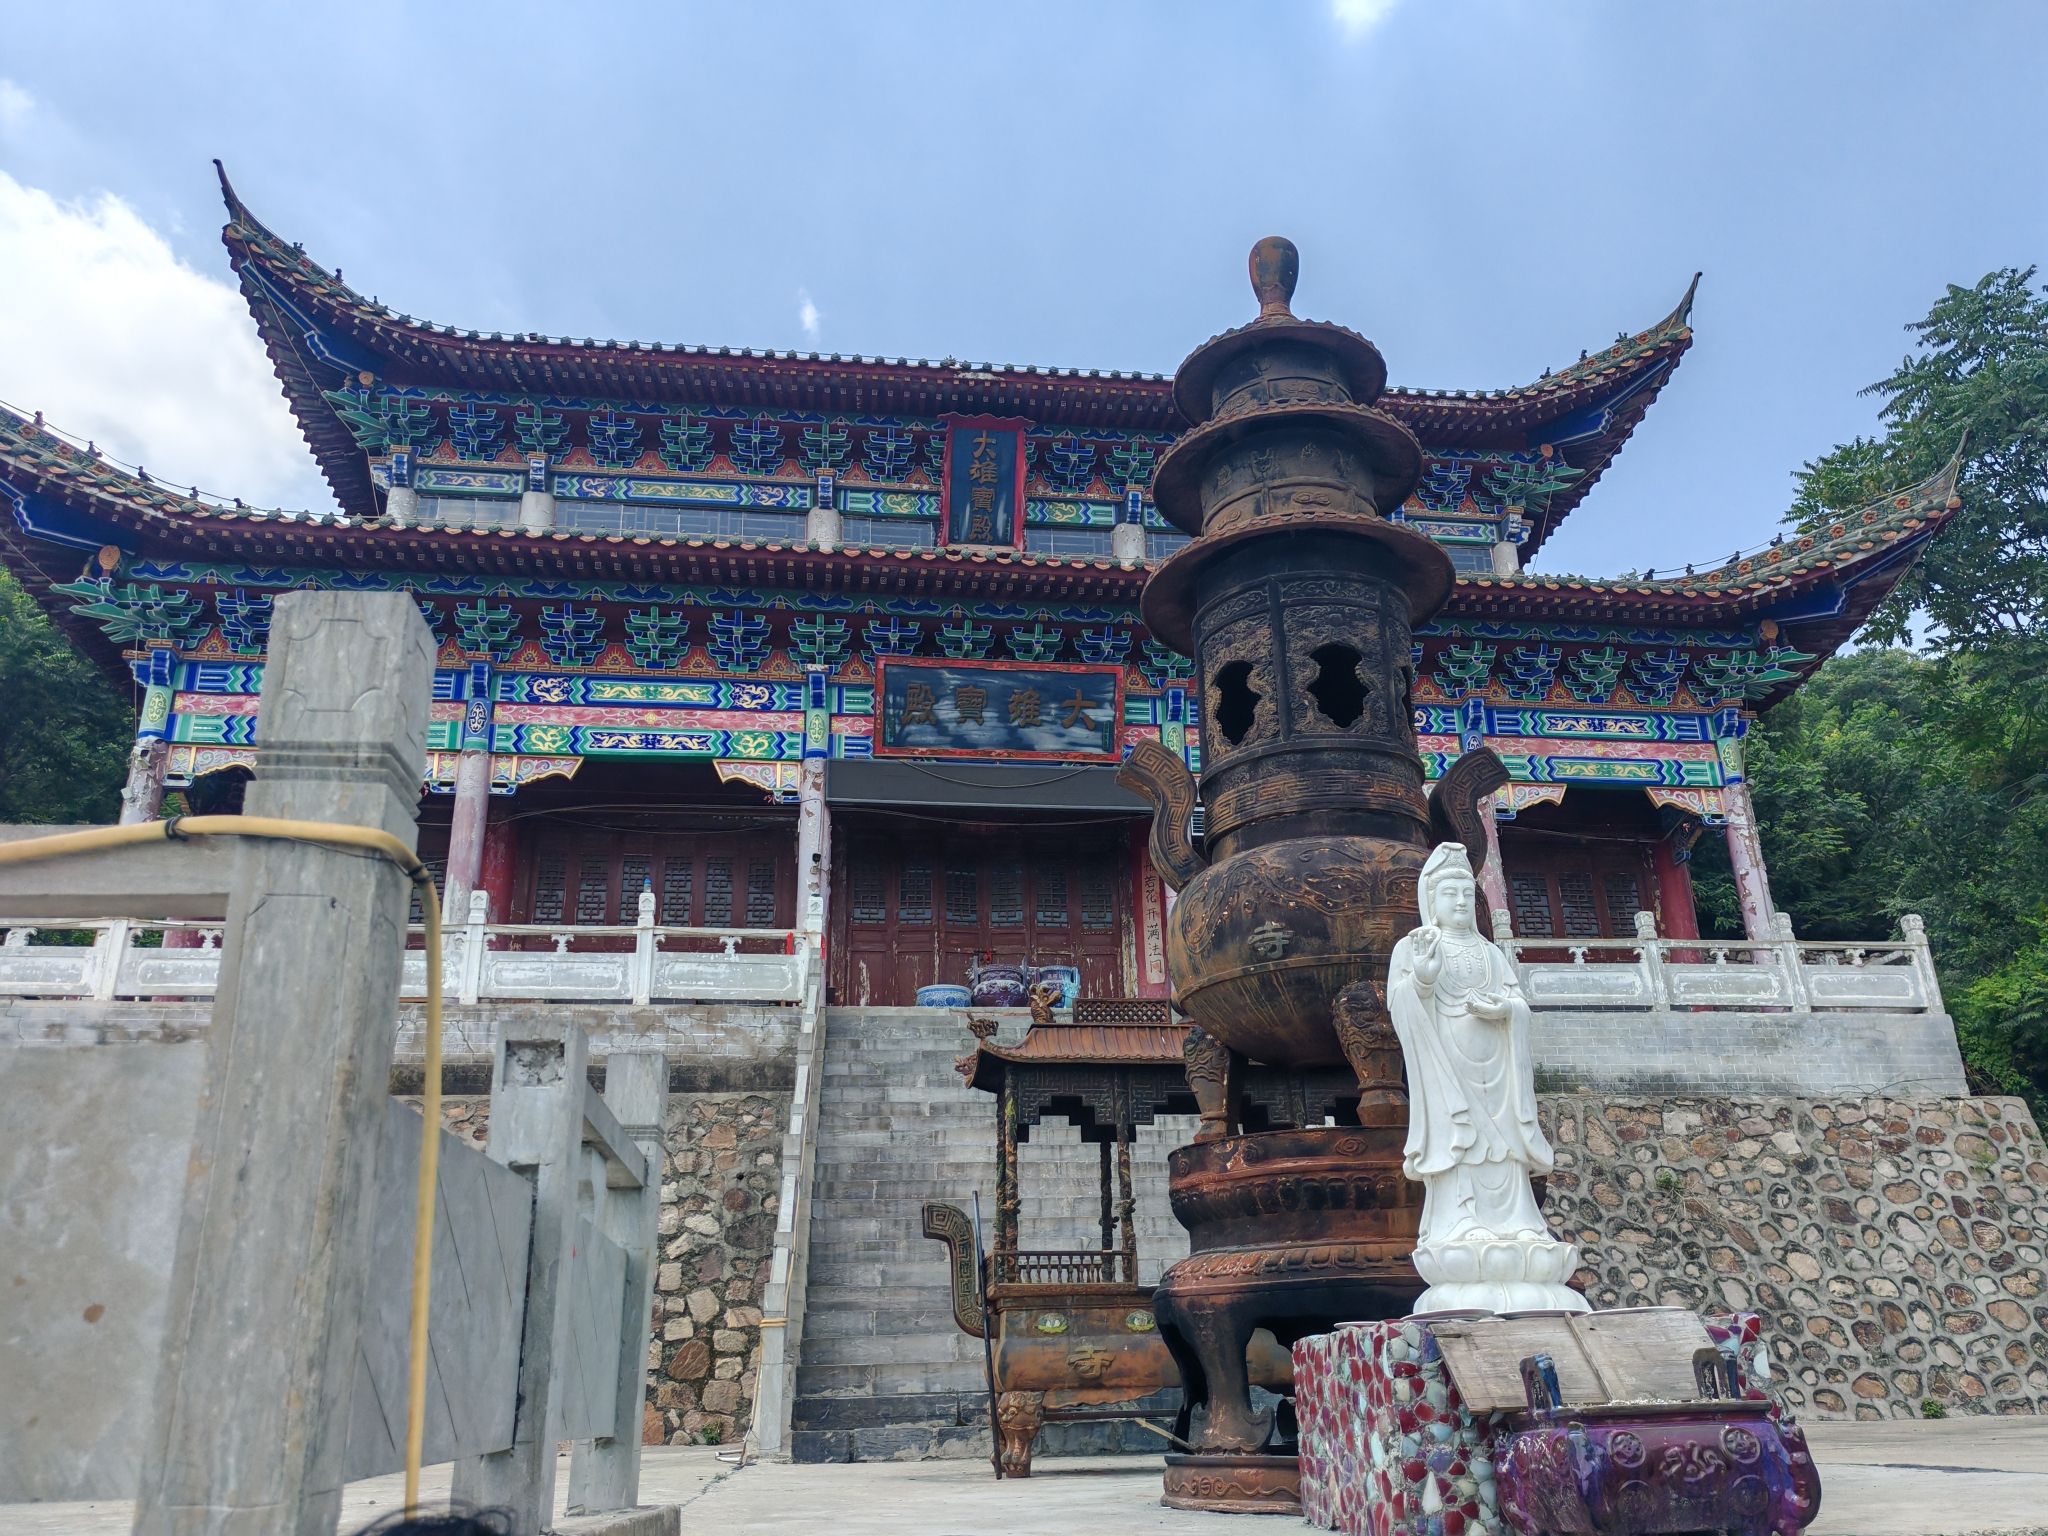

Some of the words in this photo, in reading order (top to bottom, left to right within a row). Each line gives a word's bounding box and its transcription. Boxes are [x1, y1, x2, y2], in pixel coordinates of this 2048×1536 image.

[968, 430, 999, 542] 大雄寶殿
[901, 683, 1098, 731] 大雄寶殿
[1248, 920, 1294, 959] 寺
